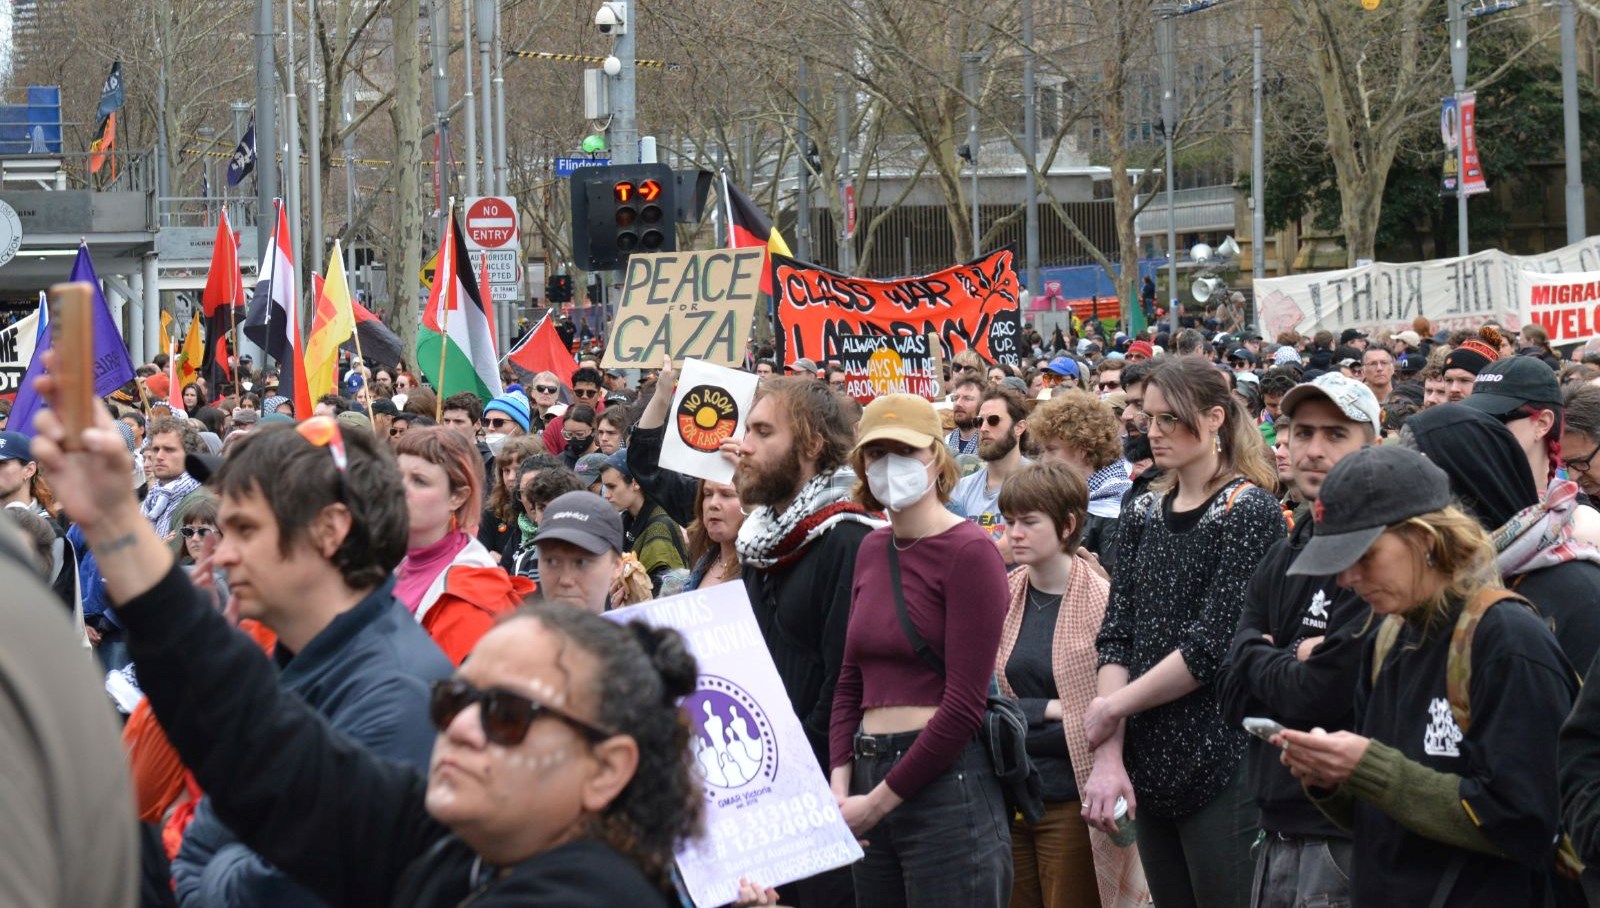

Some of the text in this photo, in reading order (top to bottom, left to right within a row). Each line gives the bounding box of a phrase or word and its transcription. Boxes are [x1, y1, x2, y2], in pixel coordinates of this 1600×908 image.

[483, 205, 498, 216] NO
[473, 230, 509, 241] ENTRY
[622, 252, 760, 307] PEACE
[786, 272, 983, 314] CLASS WAR FOR
[1531, 280, 1600, 306] MIGRA
[668, 303, 699, 312] FOR
[613, 309, 736, 363] GAZA
[991, 321, 1016, 337] ARC
[842, 335, 926, 354] ALWAYS WAS
[995, 337, 1016, 352] UP.
[845, 357, 938, 379] ALWAYS WILL BE
[684, 389, 734, 415] NO ROOM
[680, 416, 732, 446] FOR RACISM
